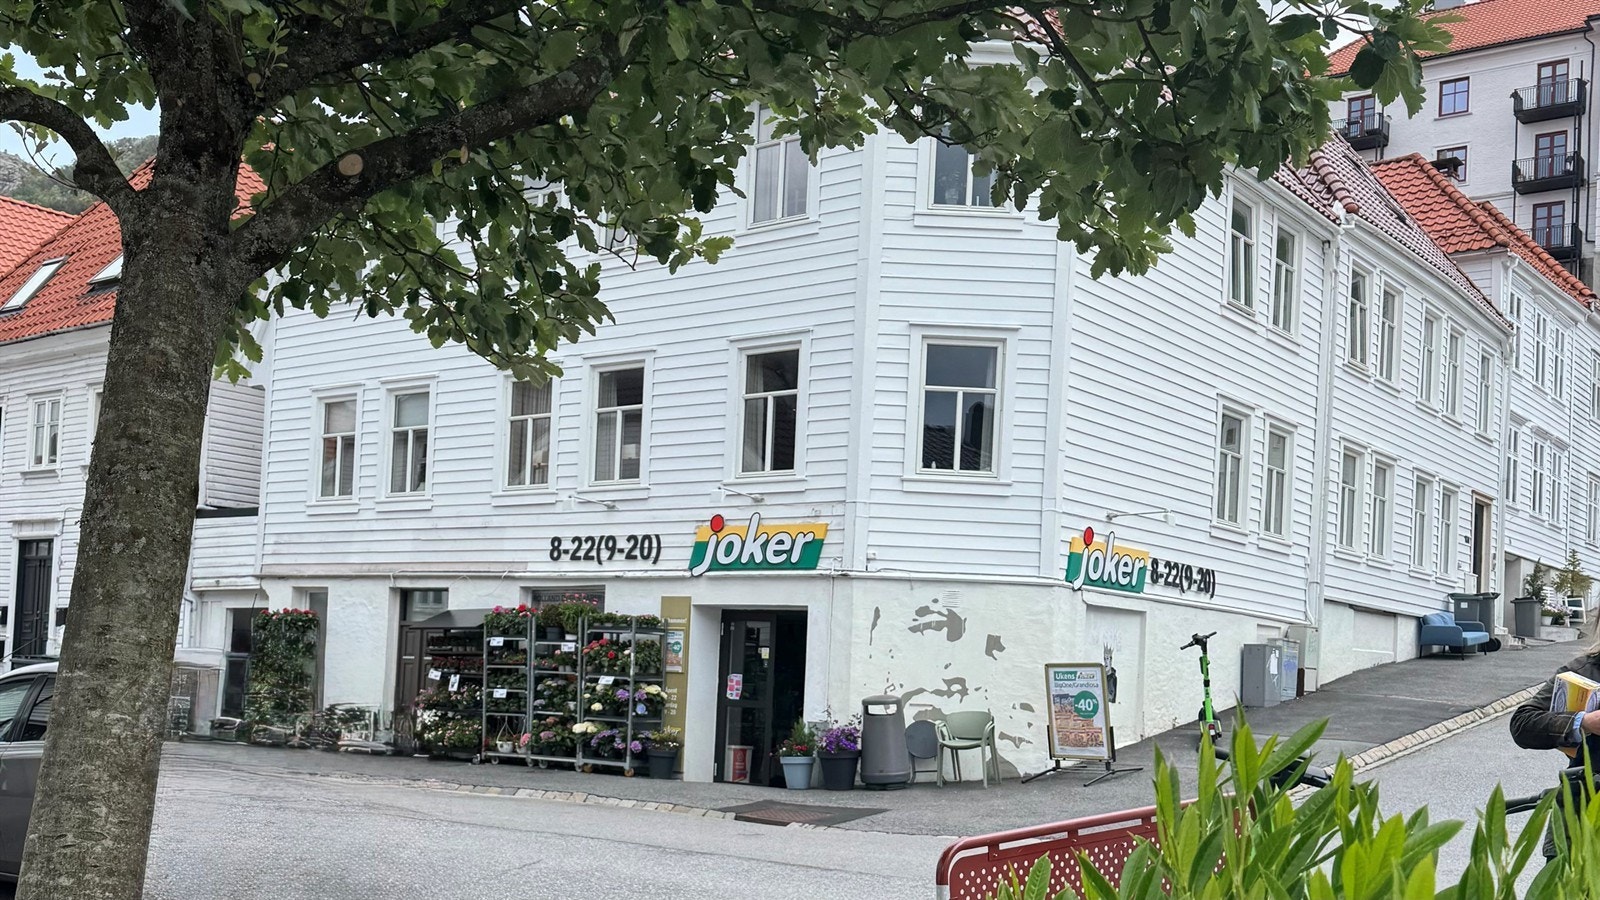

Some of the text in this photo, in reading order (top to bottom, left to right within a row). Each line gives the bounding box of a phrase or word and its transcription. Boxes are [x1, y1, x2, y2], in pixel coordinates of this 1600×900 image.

[549, 534, 662, 566] 8-22(9-20)
[691, 512, 815, 576] joker
[1072, 526, 1146, 591] joker
[1150, 558, 1216, 600] 8-22(9-20)
[1055, 672, 1075, 680] Ukens
